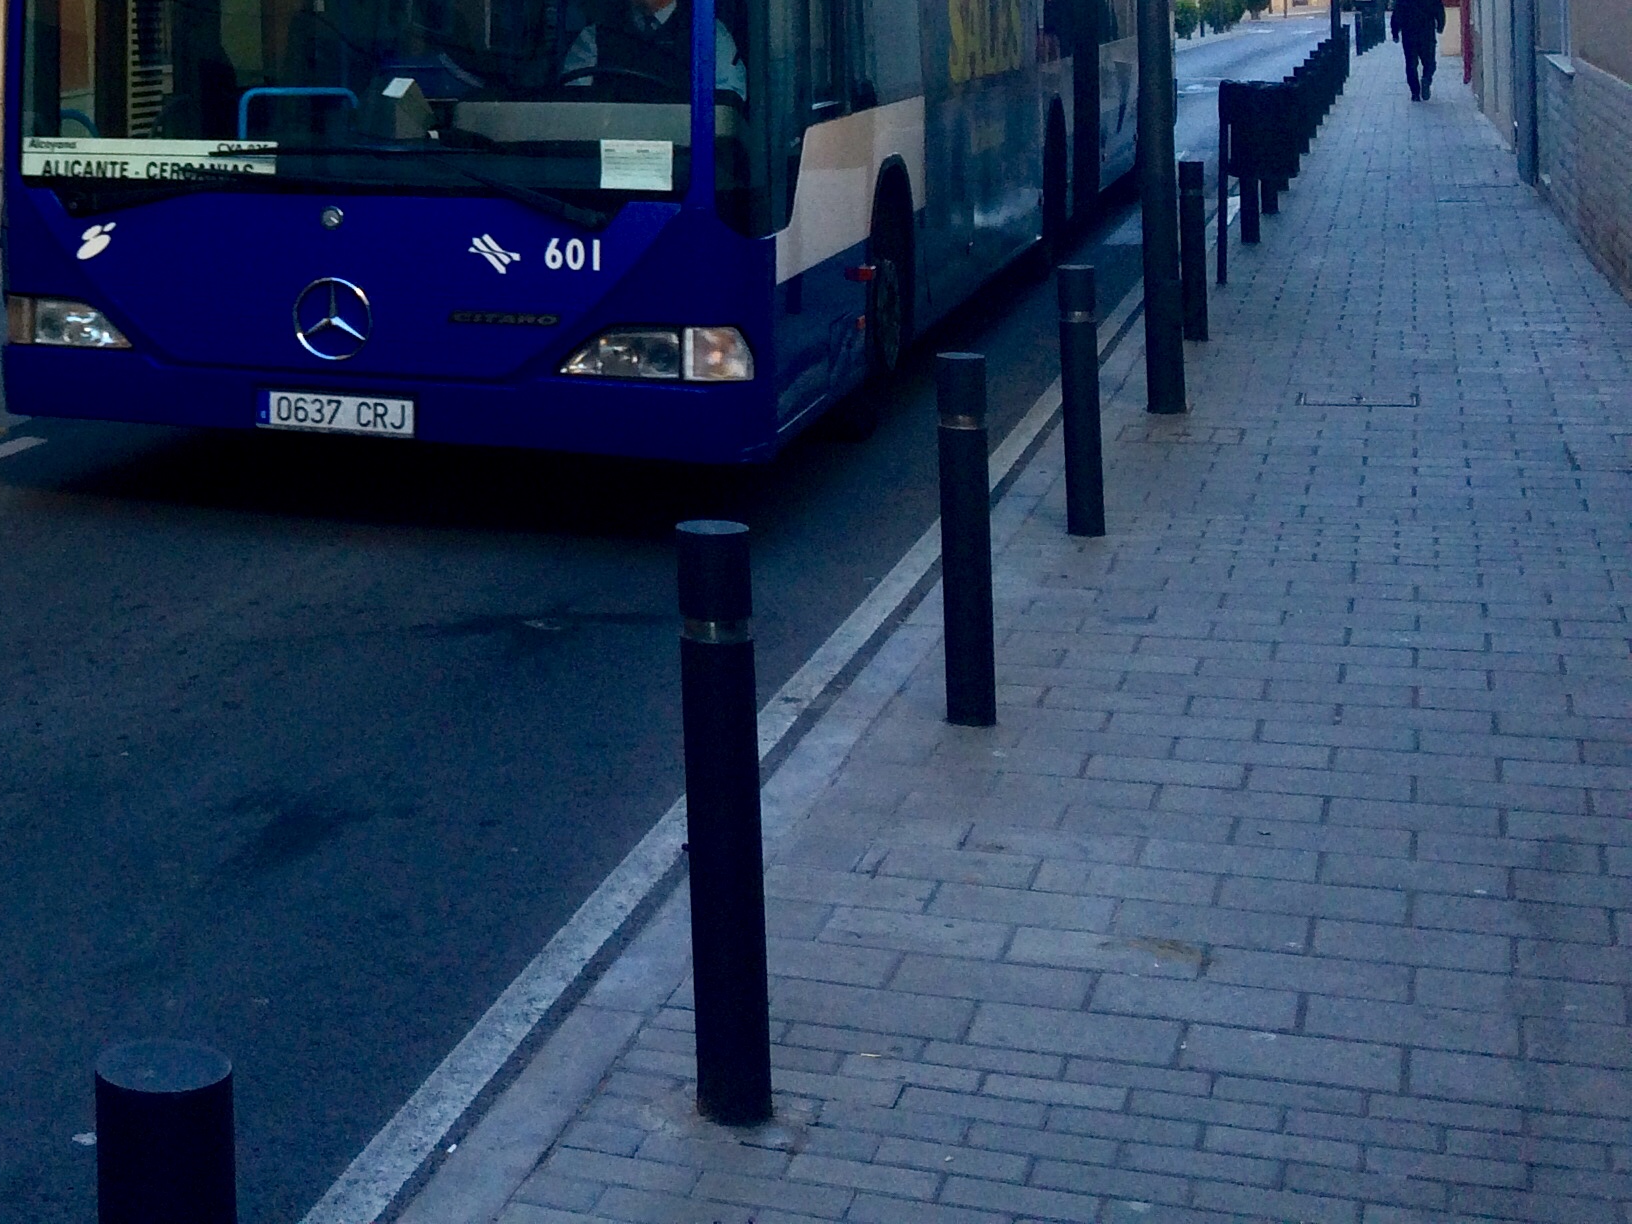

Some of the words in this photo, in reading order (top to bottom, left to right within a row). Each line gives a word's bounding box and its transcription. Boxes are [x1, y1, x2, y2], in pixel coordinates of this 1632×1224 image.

[41, 159, 130, 179] ALICANTE
[544, 237, 601, 272] 601
[276, 395, 343, 426] 0637
[356, 401, 406, 431] CRJ
